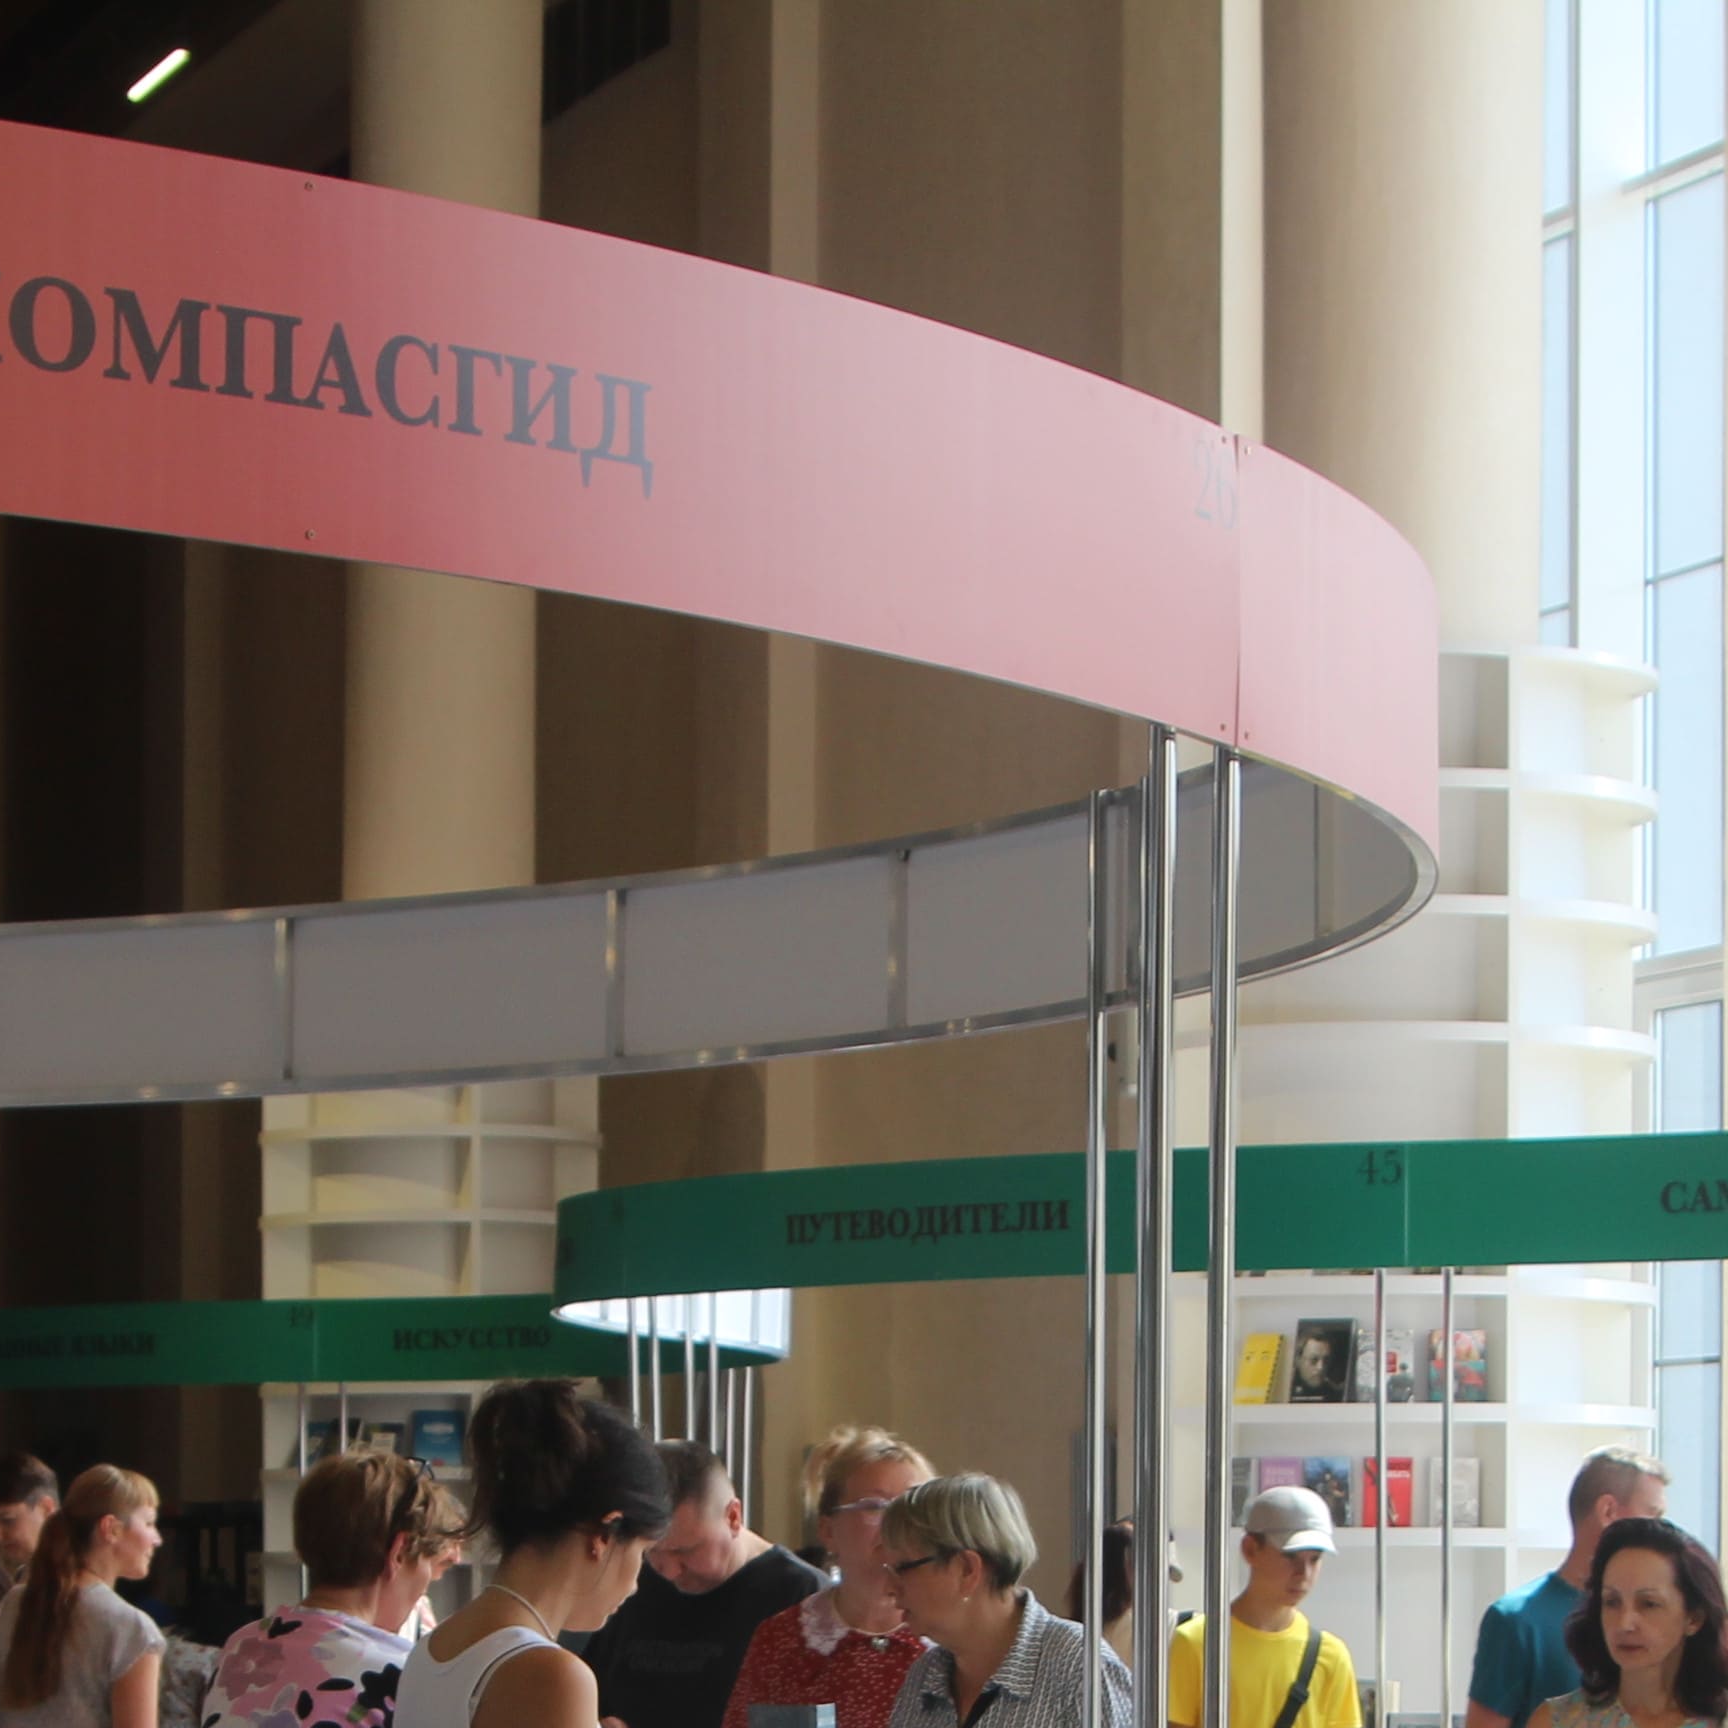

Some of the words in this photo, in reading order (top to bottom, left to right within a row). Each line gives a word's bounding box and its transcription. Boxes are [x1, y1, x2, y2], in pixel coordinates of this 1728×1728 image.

[1356, 1147, 1403, 1187] 45
[786, 1199, 1071, 1248] ПУТЕВОДИТЕЛИ
[392, 1325, 552, 1351] ИСКУССТВО
